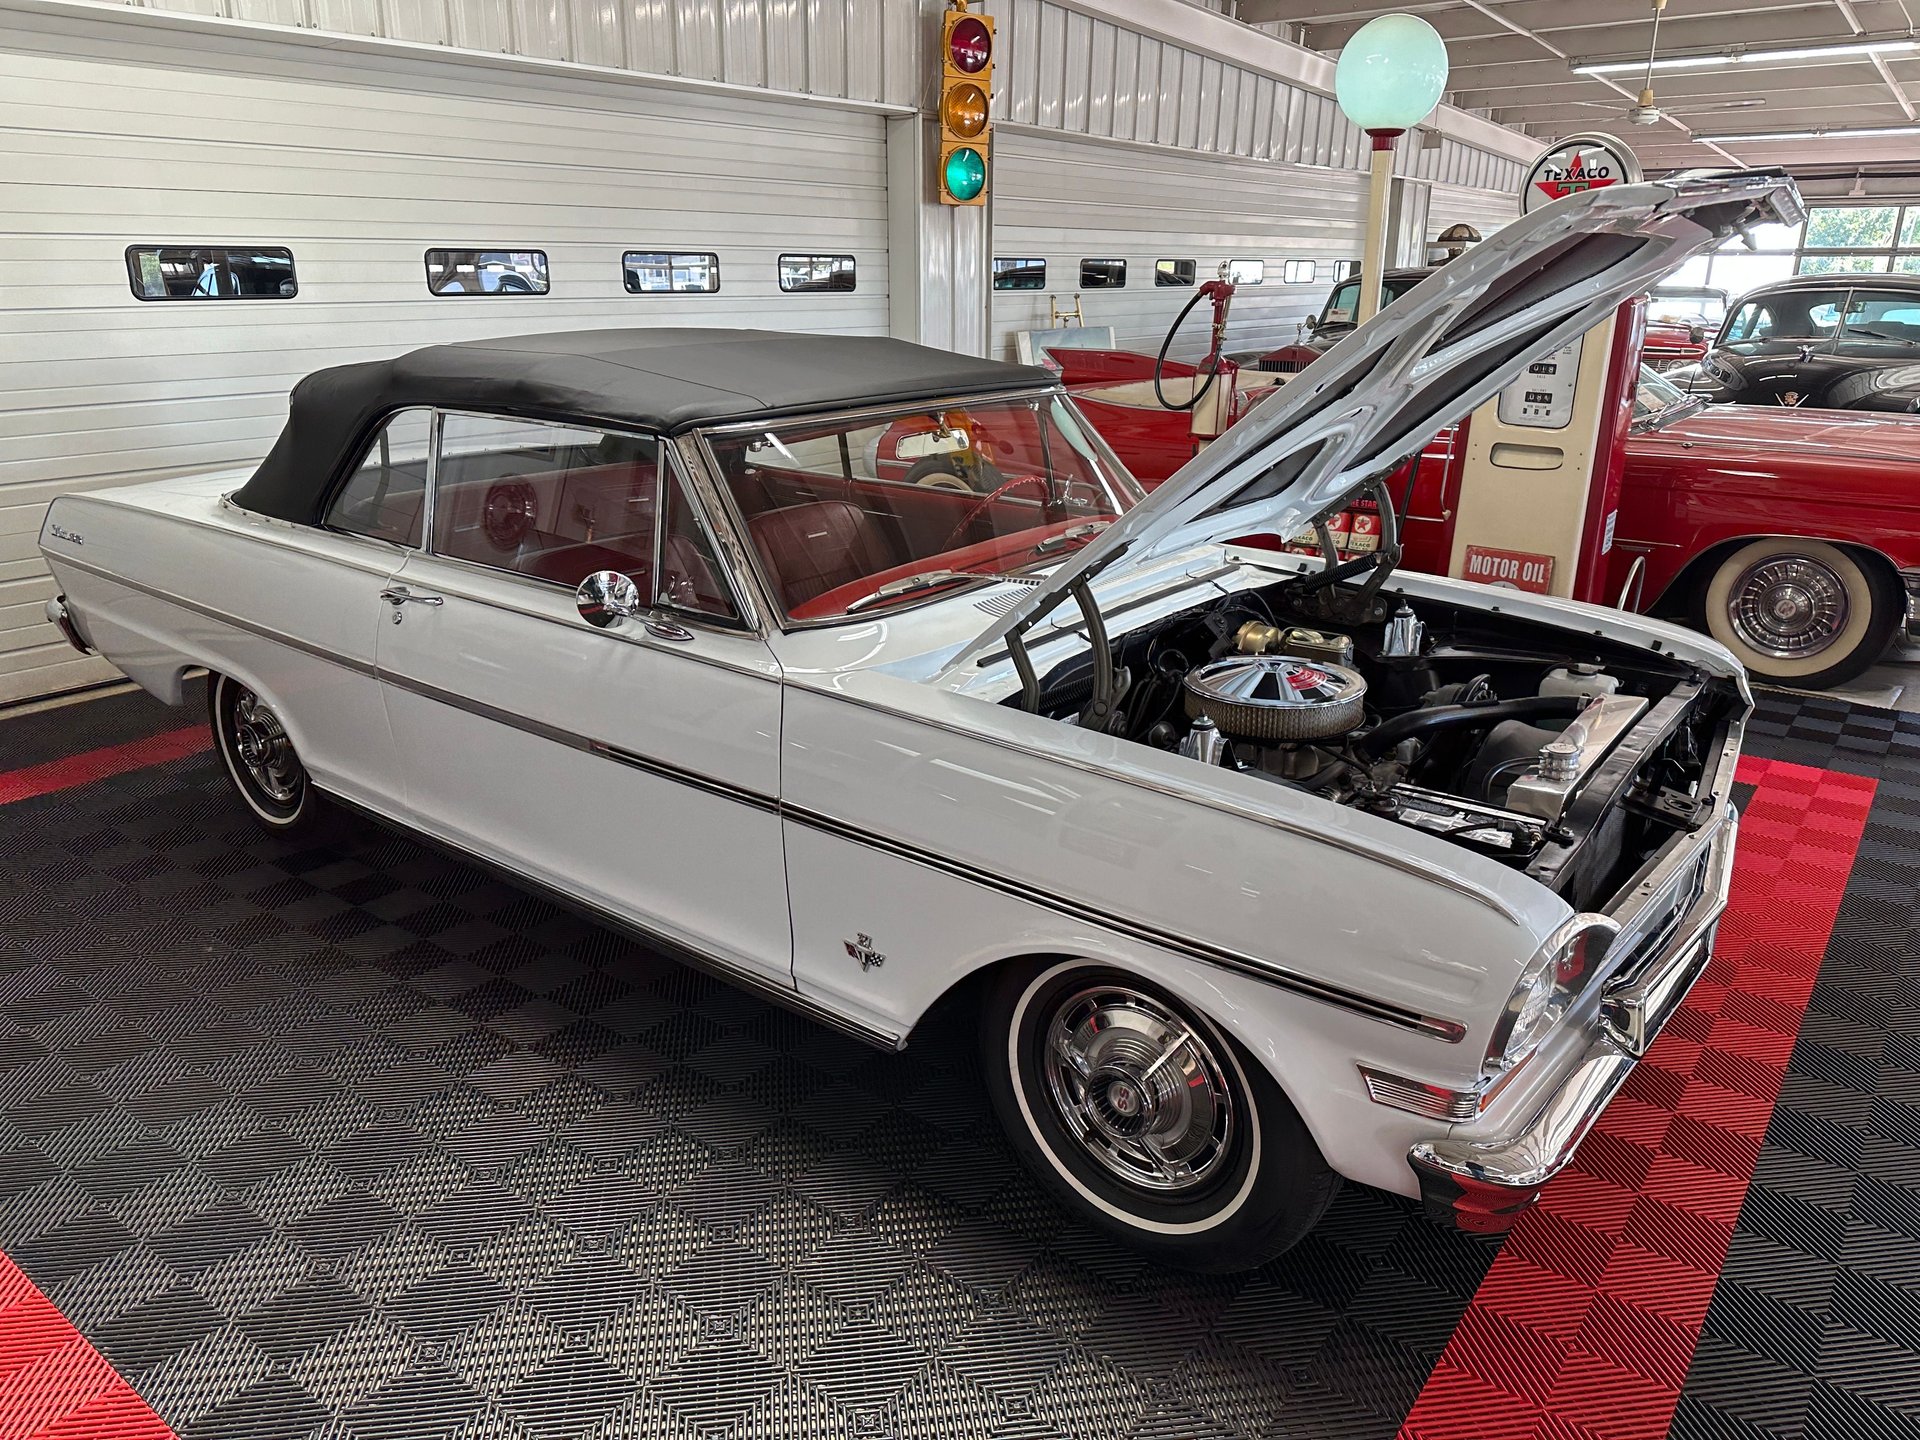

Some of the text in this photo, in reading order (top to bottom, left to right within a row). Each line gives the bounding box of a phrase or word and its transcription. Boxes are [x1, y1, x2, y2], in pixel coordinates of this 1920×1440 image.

[1544, 167, 1610, 182] TEXACO
[1361, 500, 1377, 508] STAR
[1469, 554, 1545, 584] MOTOR OIL
